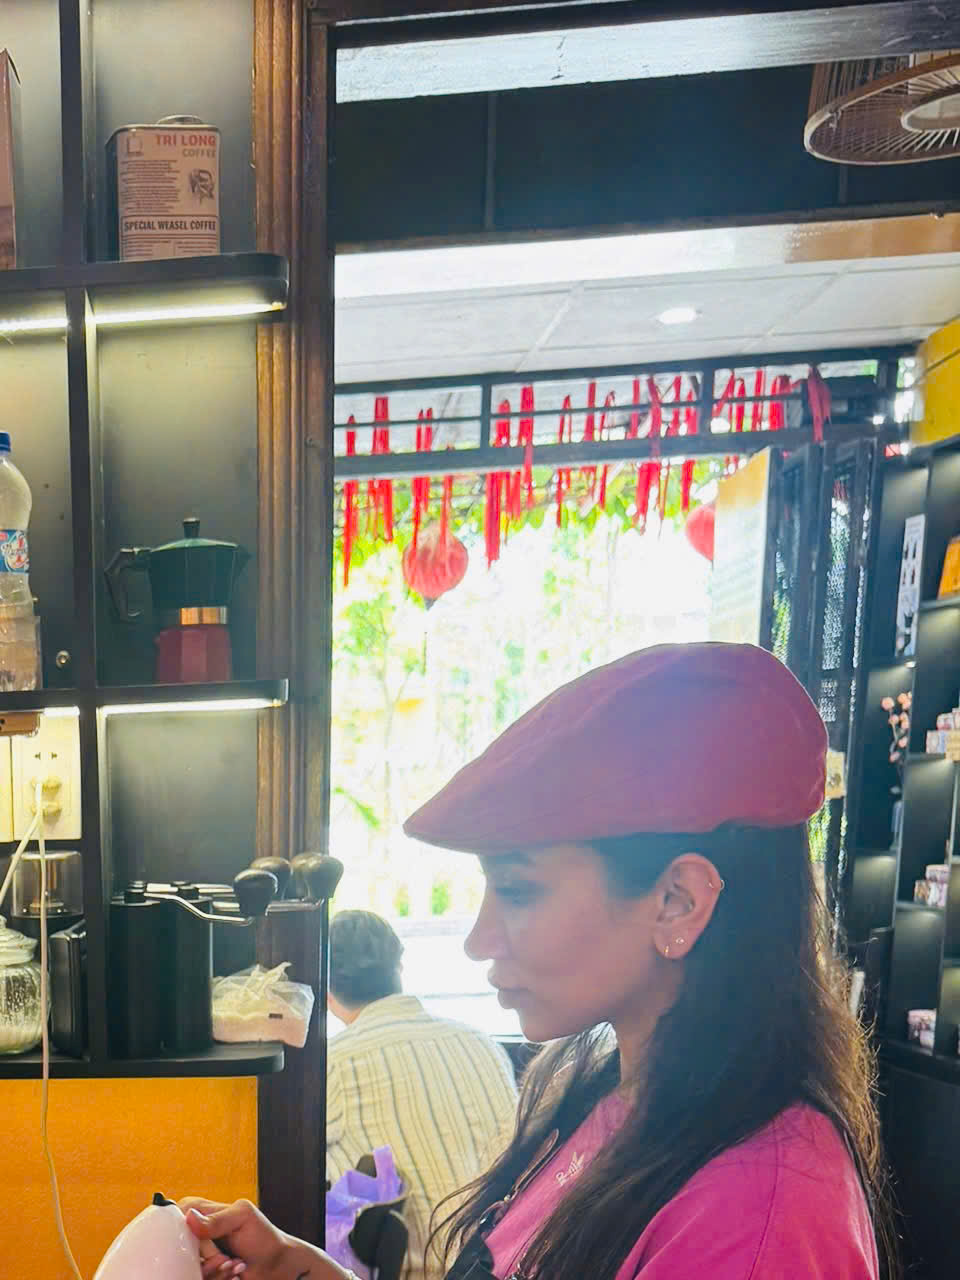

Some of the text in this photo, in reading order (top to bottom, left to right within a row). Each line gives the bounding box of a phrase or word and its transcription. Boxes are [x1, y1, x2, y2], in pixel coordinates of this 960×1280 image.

[181, 135, 217, 146] LONG
[182, 148, 217, 159] COFFEE
[123, 220, 217, 232] SPECIAL WEASEL COFFEE
